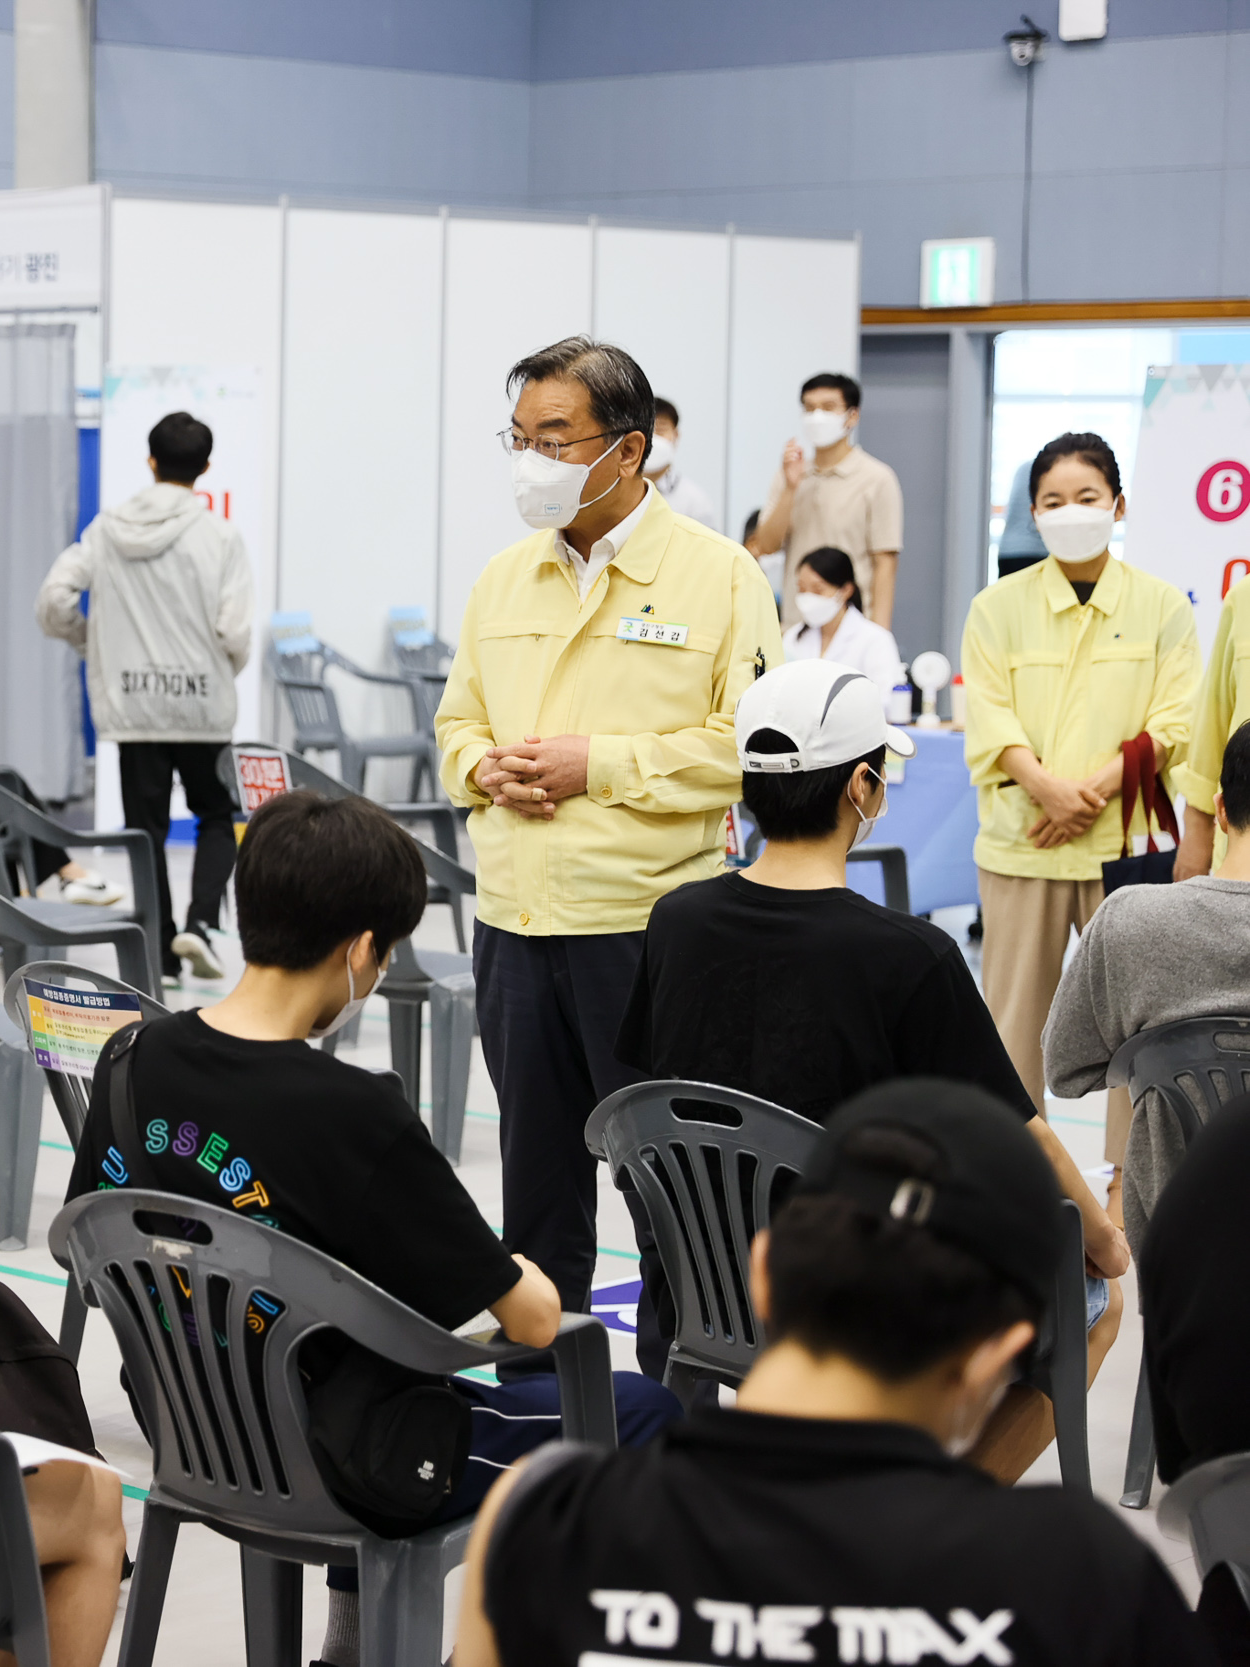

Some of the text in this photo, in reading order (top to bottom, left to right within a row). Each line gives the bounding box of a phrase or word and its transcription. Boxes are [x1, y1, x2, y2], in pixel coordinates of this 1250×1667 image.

[25, 252, 59, 283] 광진
[240, 757, 284, 789] 30분
[589, 1588, 1015, 1667] TO THE MAX
